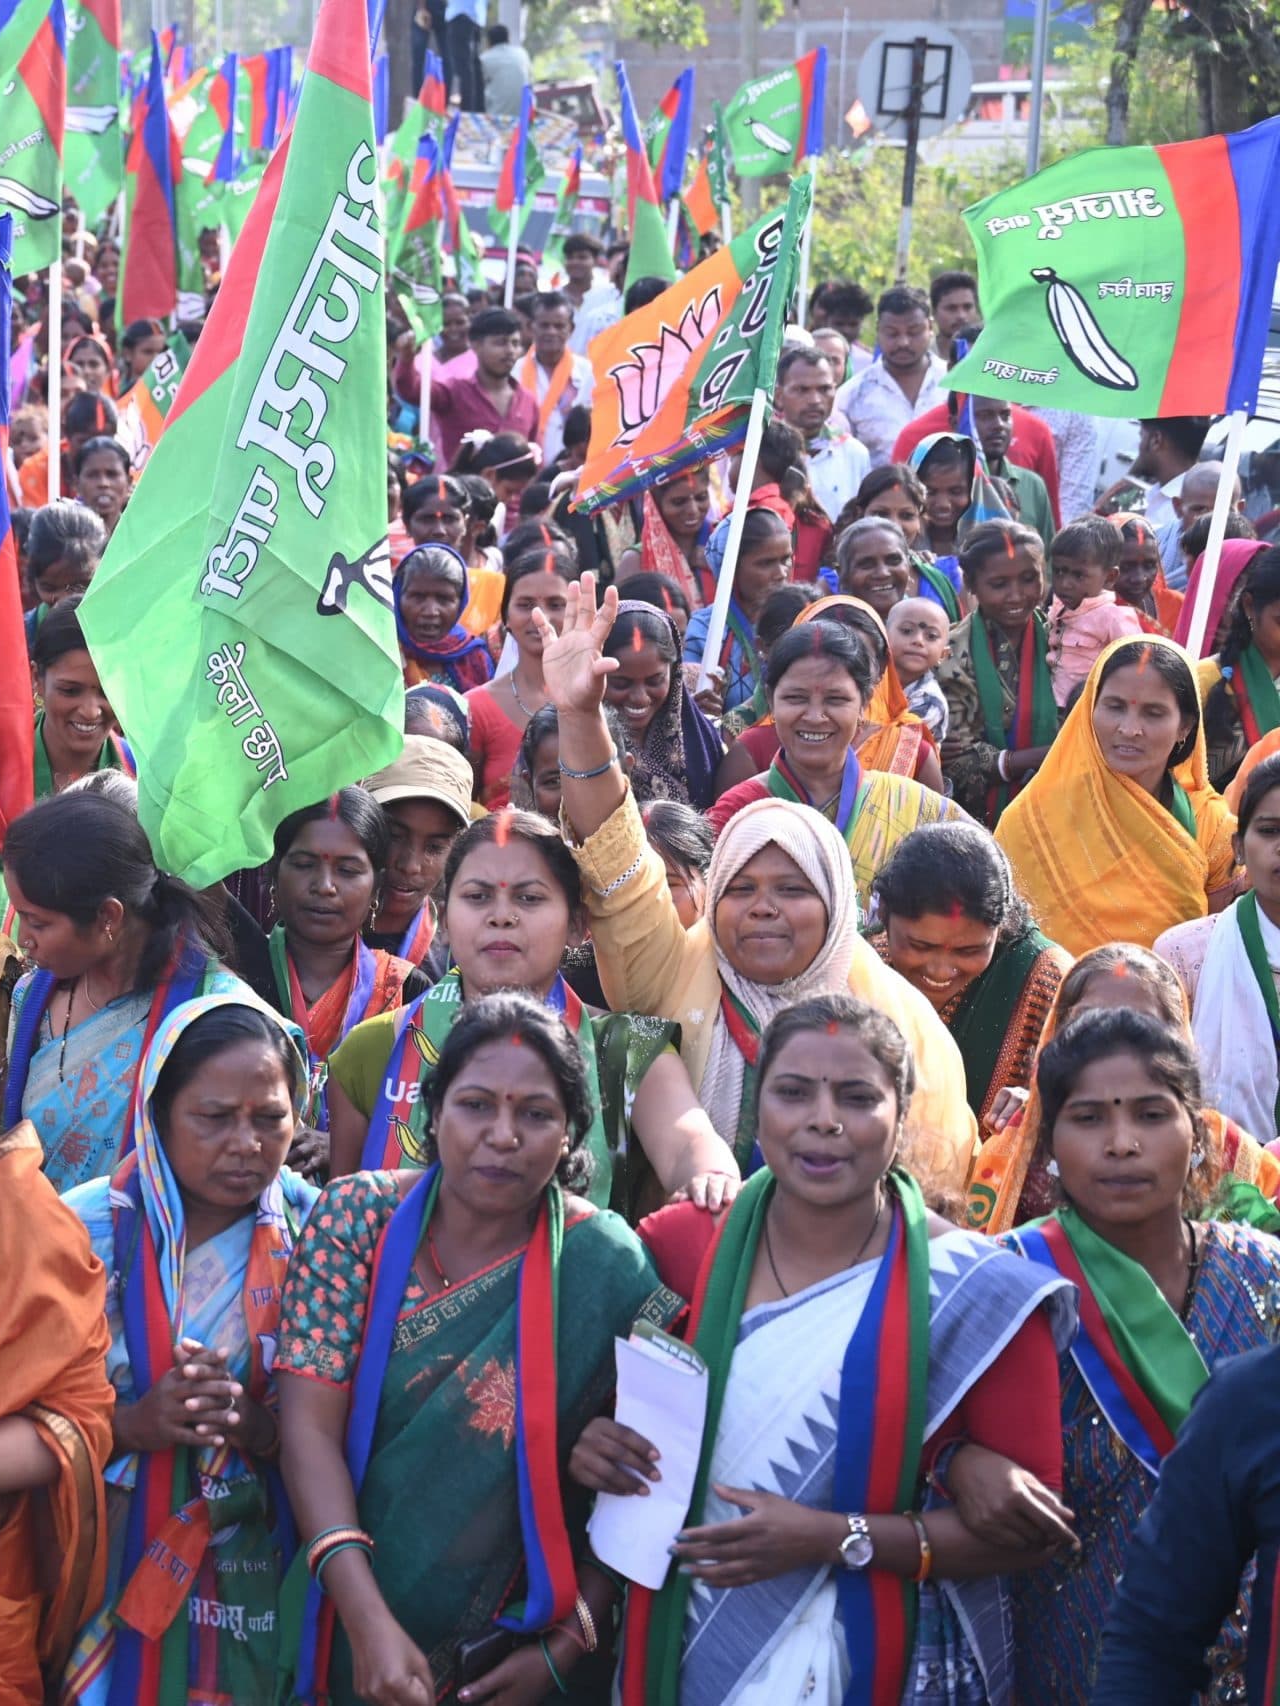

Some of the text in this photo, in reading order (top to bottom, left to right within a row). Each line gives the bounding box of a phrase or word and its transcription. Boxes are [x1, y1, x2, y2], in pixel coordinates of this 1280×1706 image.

[205, 641, 289, 791] केला छाप
[248, 1612, 277, 1633] पार्टी
